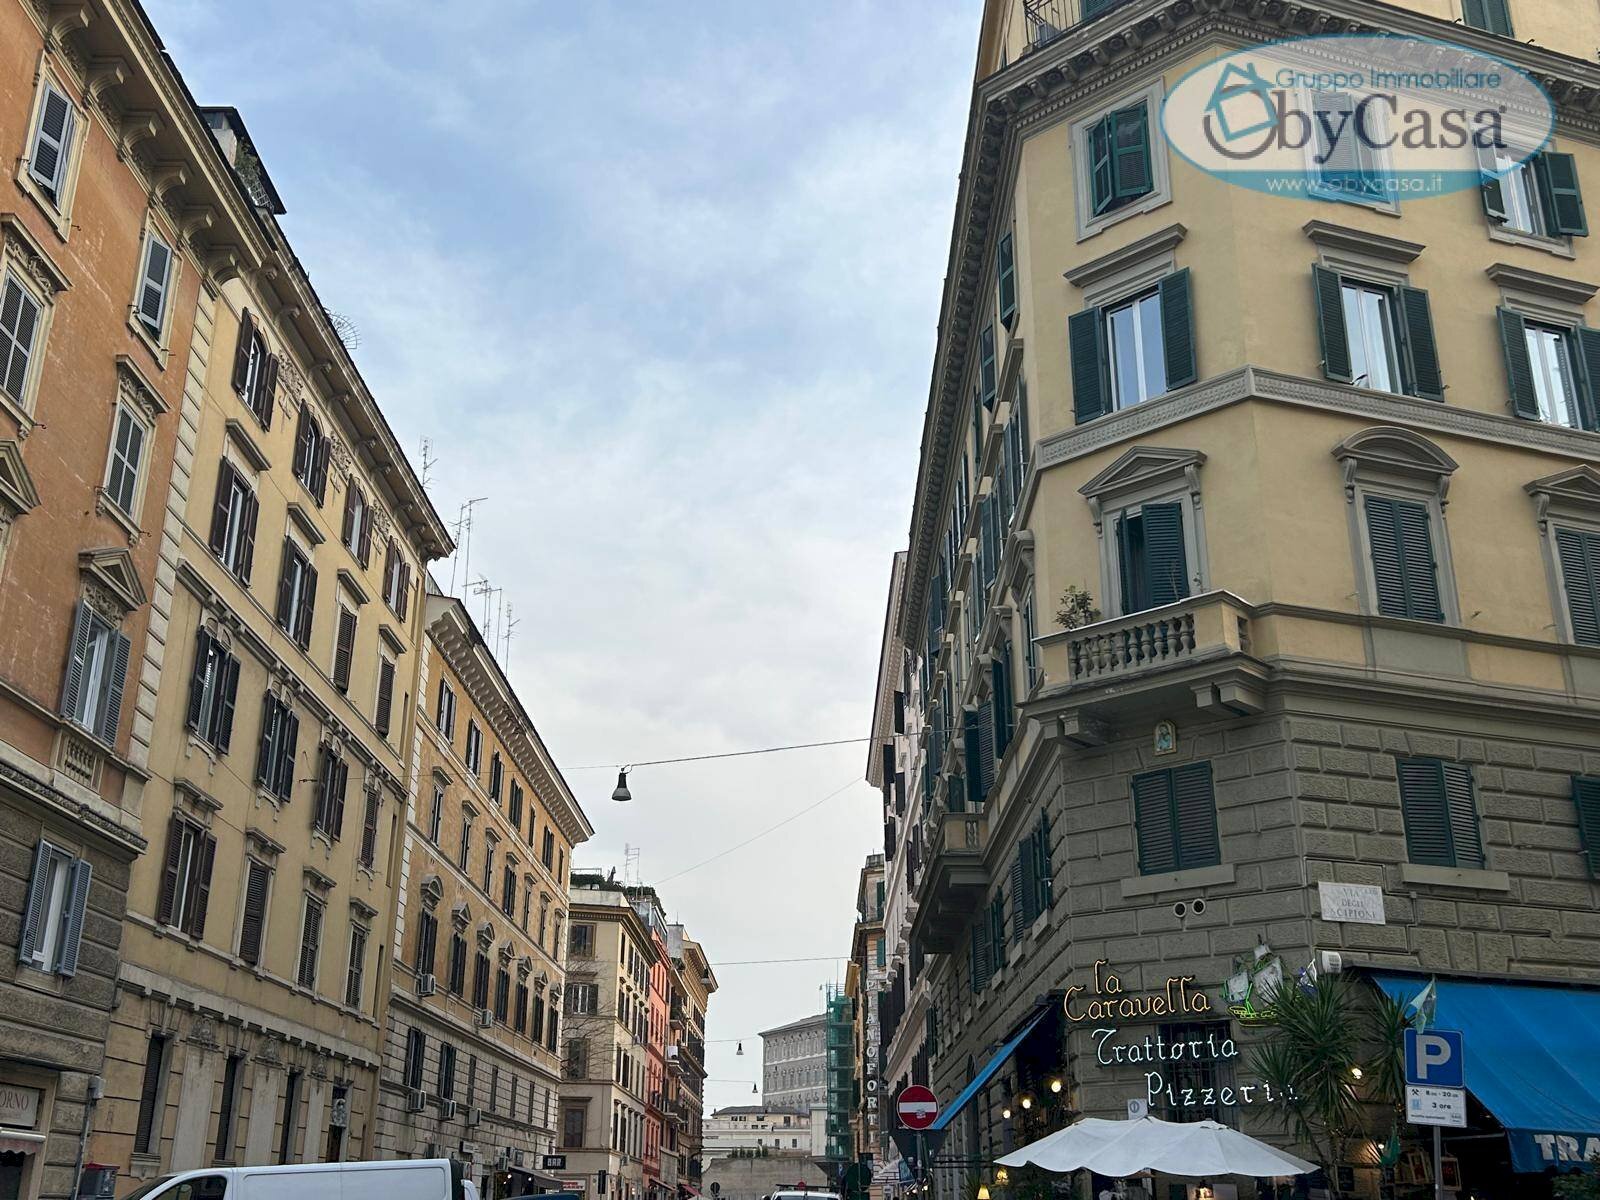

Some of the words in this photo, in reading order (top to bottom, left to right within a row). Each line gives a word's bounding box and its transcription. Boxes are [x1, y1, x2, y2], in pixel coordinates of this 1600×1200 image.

[1343, 888, 1360, 897] VIA
[1063, 976, 1212, 1021] Caravella
[866, 979, 878, 1143] PIANOFORTI
[1091, 1028, 1239, 1065] Trattoria
[1416, 1034, 1452, 1080] P
